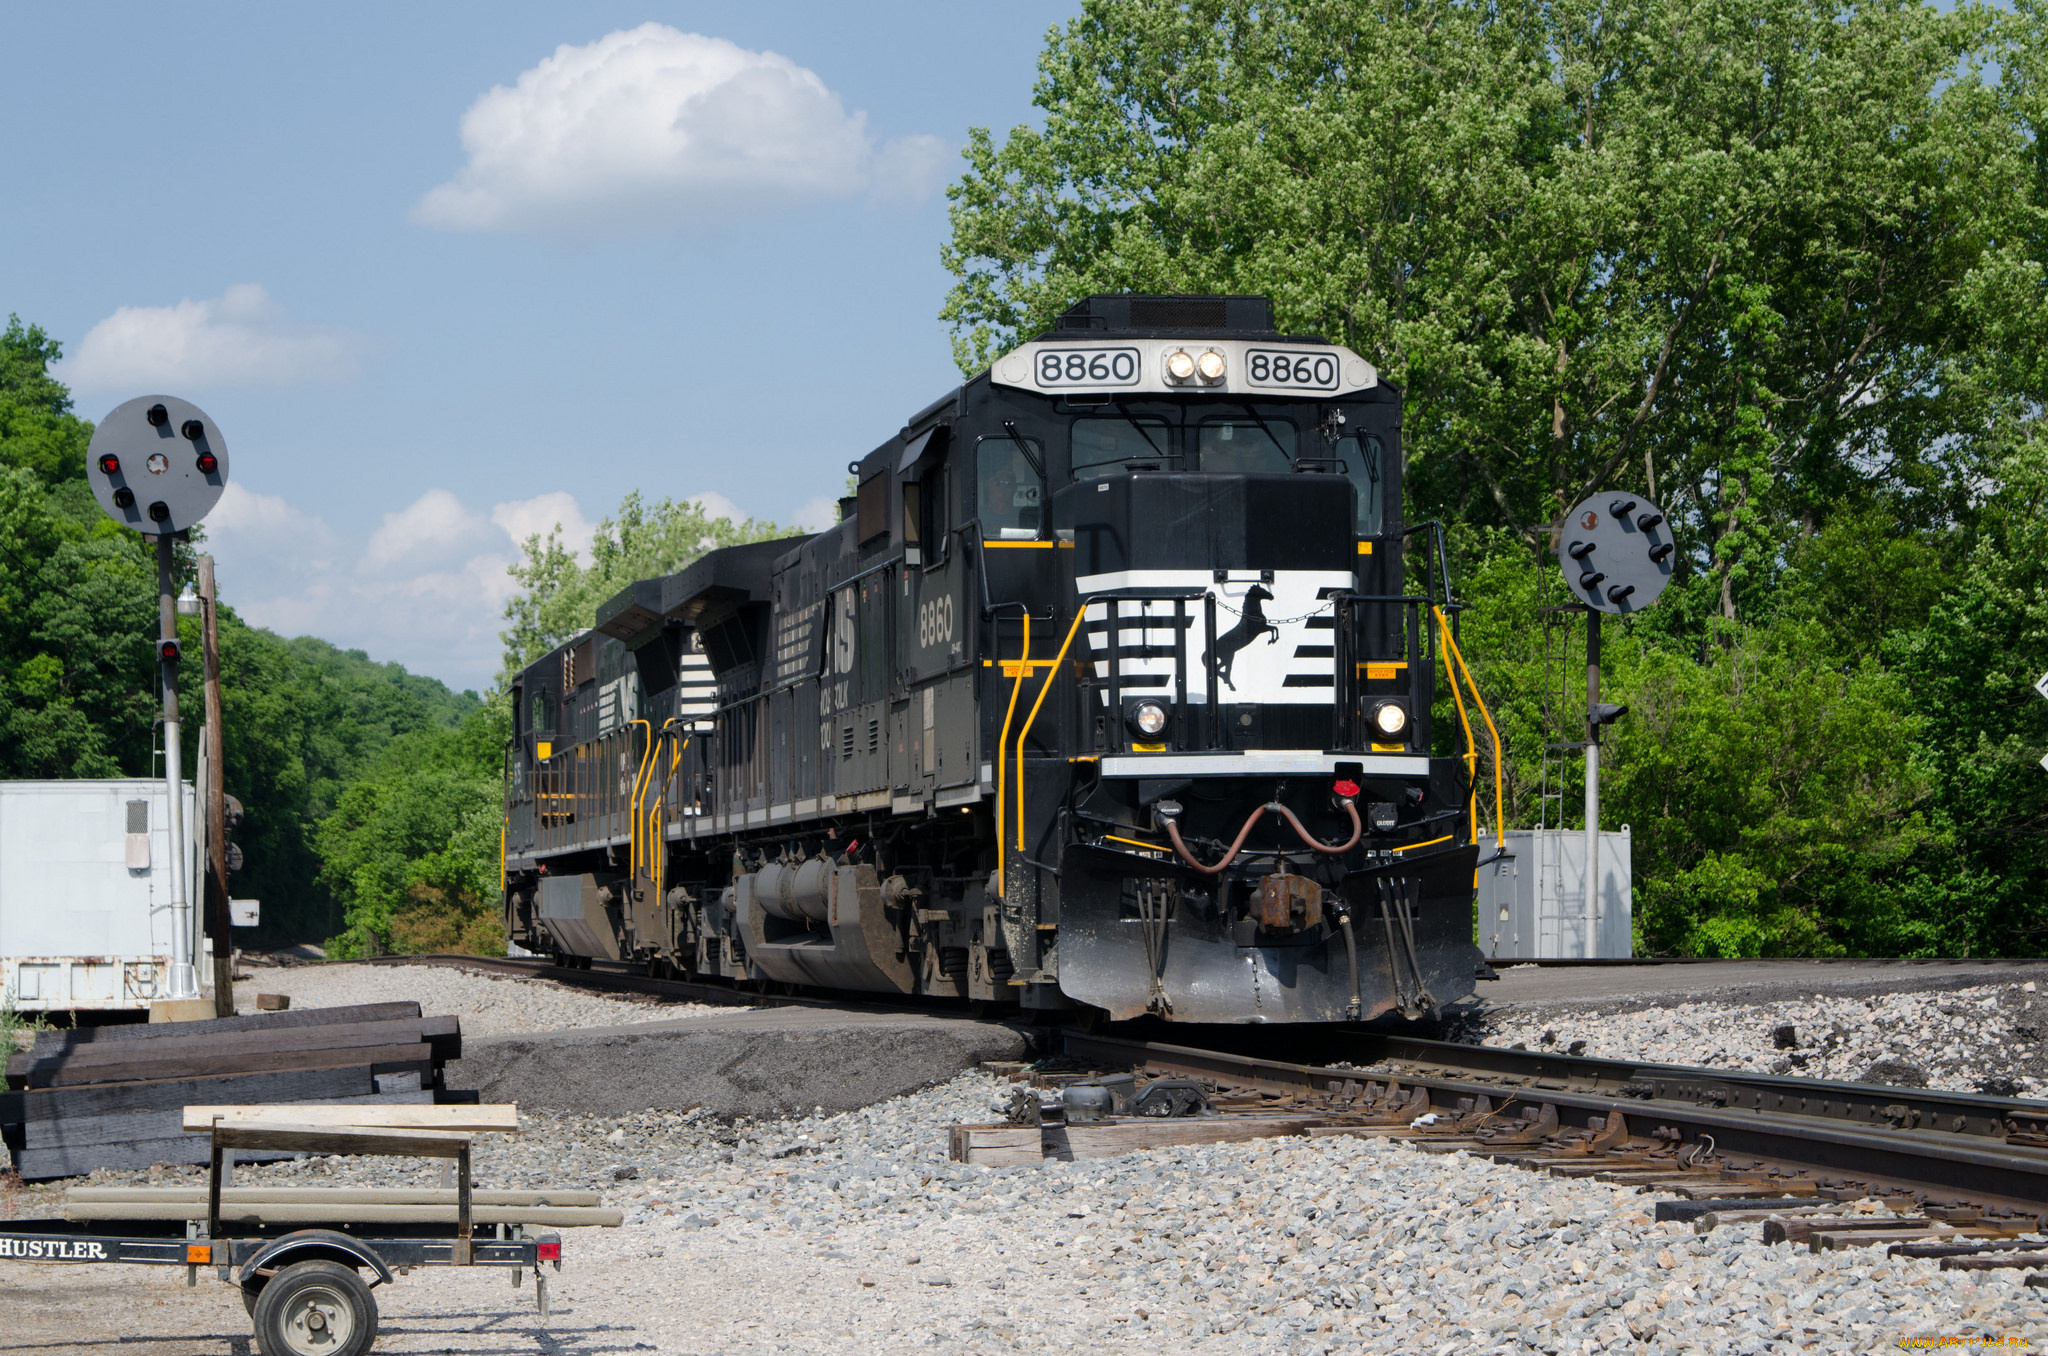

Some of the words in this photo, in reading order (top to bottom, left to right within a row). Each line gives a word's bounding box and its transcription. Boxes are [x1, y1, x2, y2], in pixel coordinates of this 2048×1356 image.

[1041, 353, 1135, 381] 8860
[1251, 354, 1334, 385] 8860
[920, 593, 953, 649] 8860
[0, 1238, 107, 1259] HUSTLER
